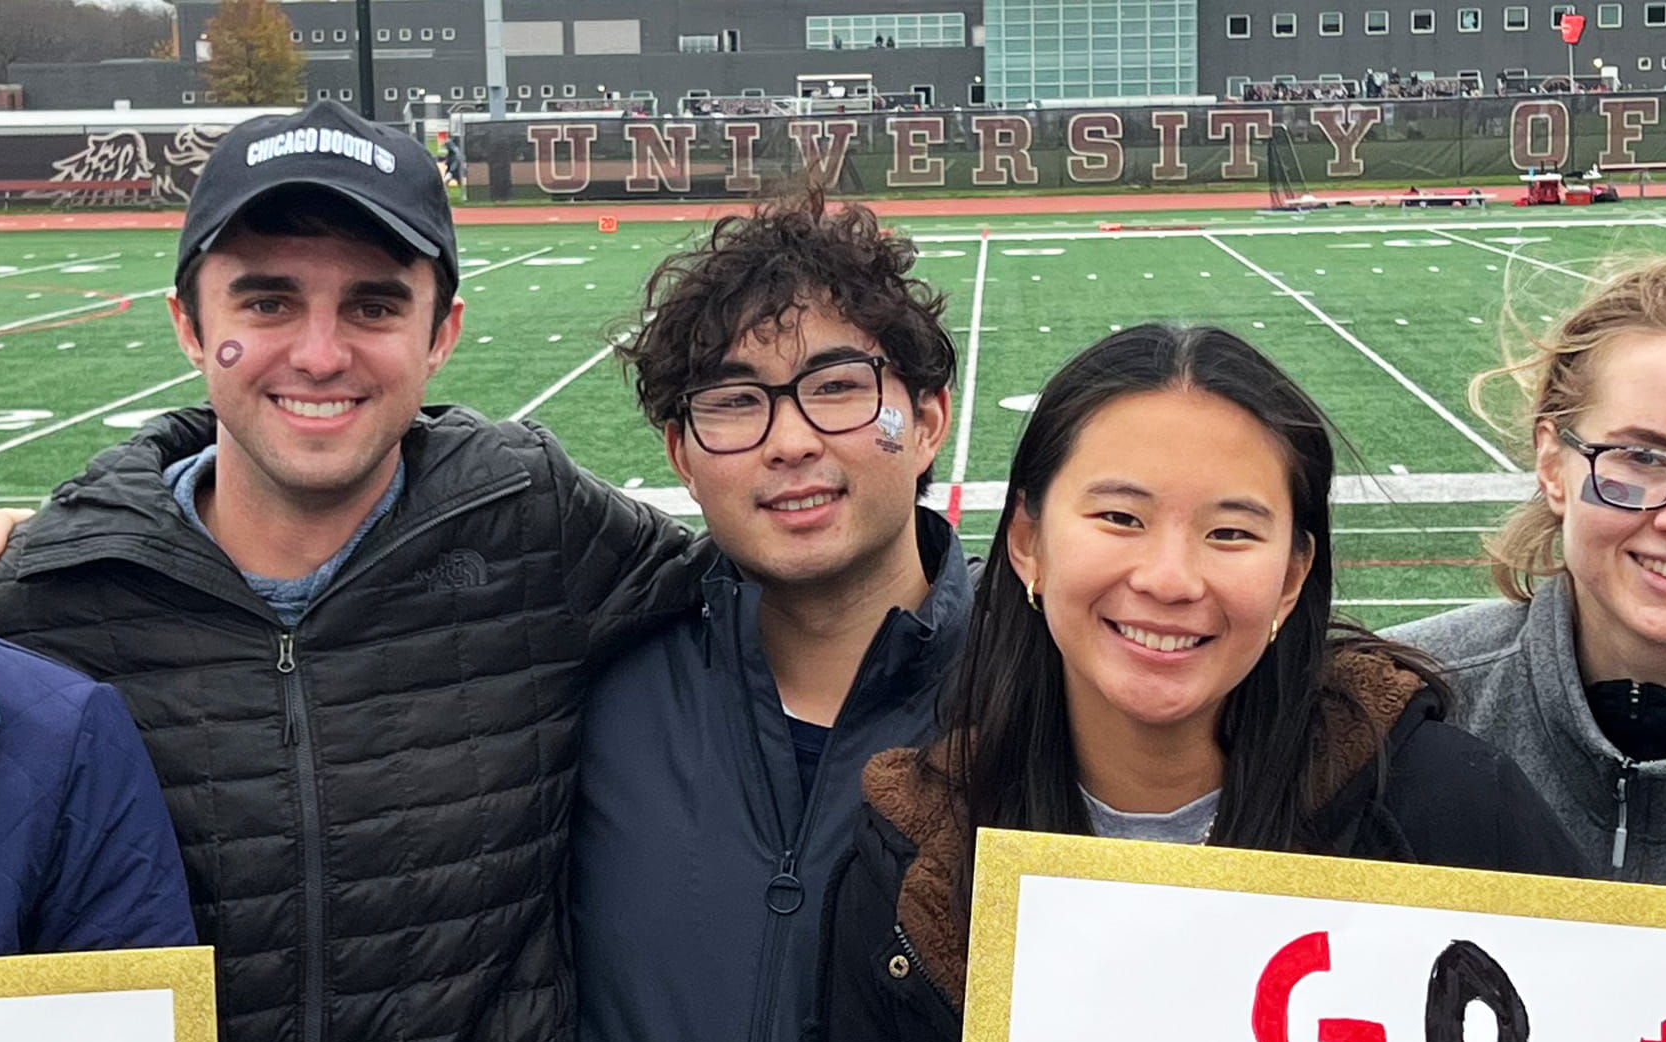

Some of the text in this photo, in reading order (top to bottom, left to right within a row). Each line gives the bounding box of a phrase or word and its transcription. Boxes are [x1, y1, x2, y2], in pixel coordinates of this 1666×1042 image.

[246, 127, 373, 166] CHICAGO BOOTH
[528, 105, 1381, 194] UNIVERSITY
[1508, 96, 1661, 171] OF
